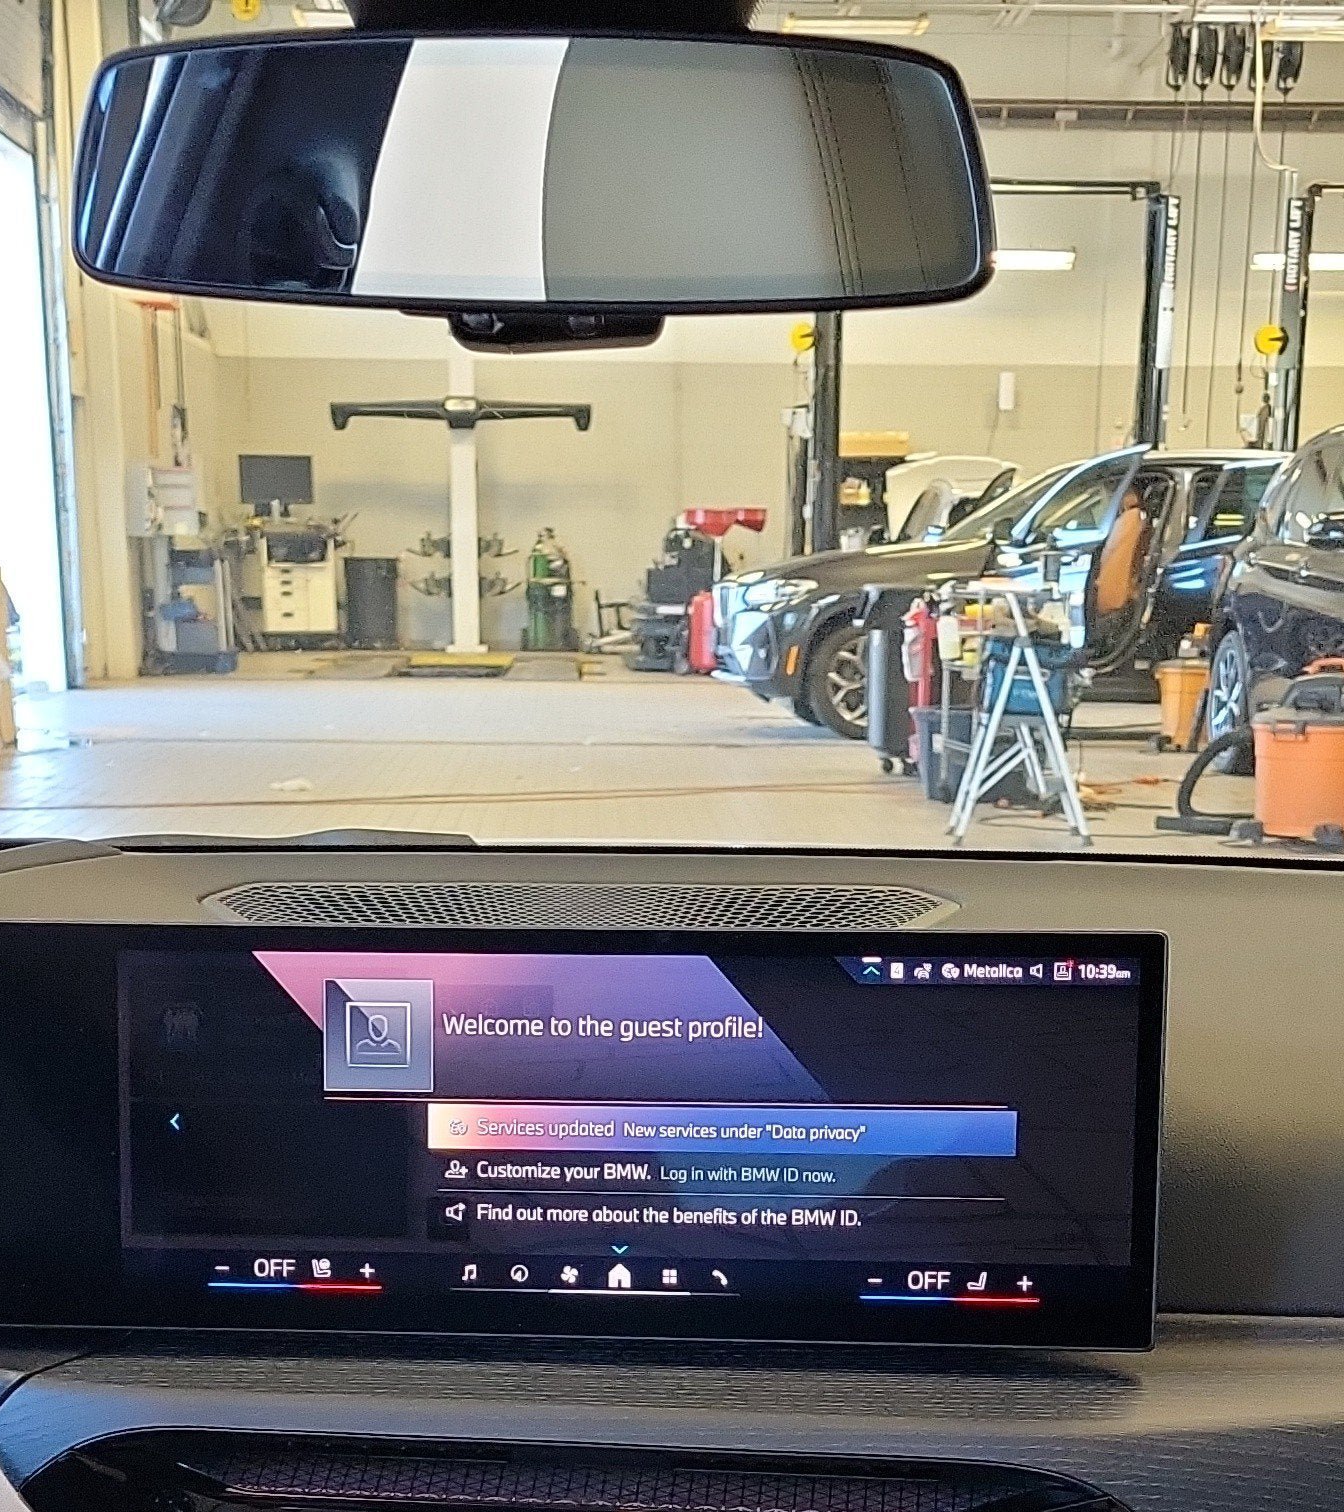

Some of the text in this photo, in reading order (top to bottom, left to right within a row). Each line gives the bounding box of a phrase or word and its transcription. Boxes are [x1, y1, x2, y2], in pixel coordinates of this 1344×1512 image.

[443, 1014, 764, 1042] Welcome to the guest profile!
[476, 1118, 615, 1140] Services updated
[623, 1122, 866, 1143] New services under "Data privacy"
[476, 1161, 652, 1182] Customize your BMW.
[660, 1166, 837, 1183] Log in with BMW ID now.
[476, 1204, 862, 1227] Find out more about the benefits of the BMW ID.
[253, 1258, 296, 1278] OFF
[907, 1270, 951, 1290] OFF
